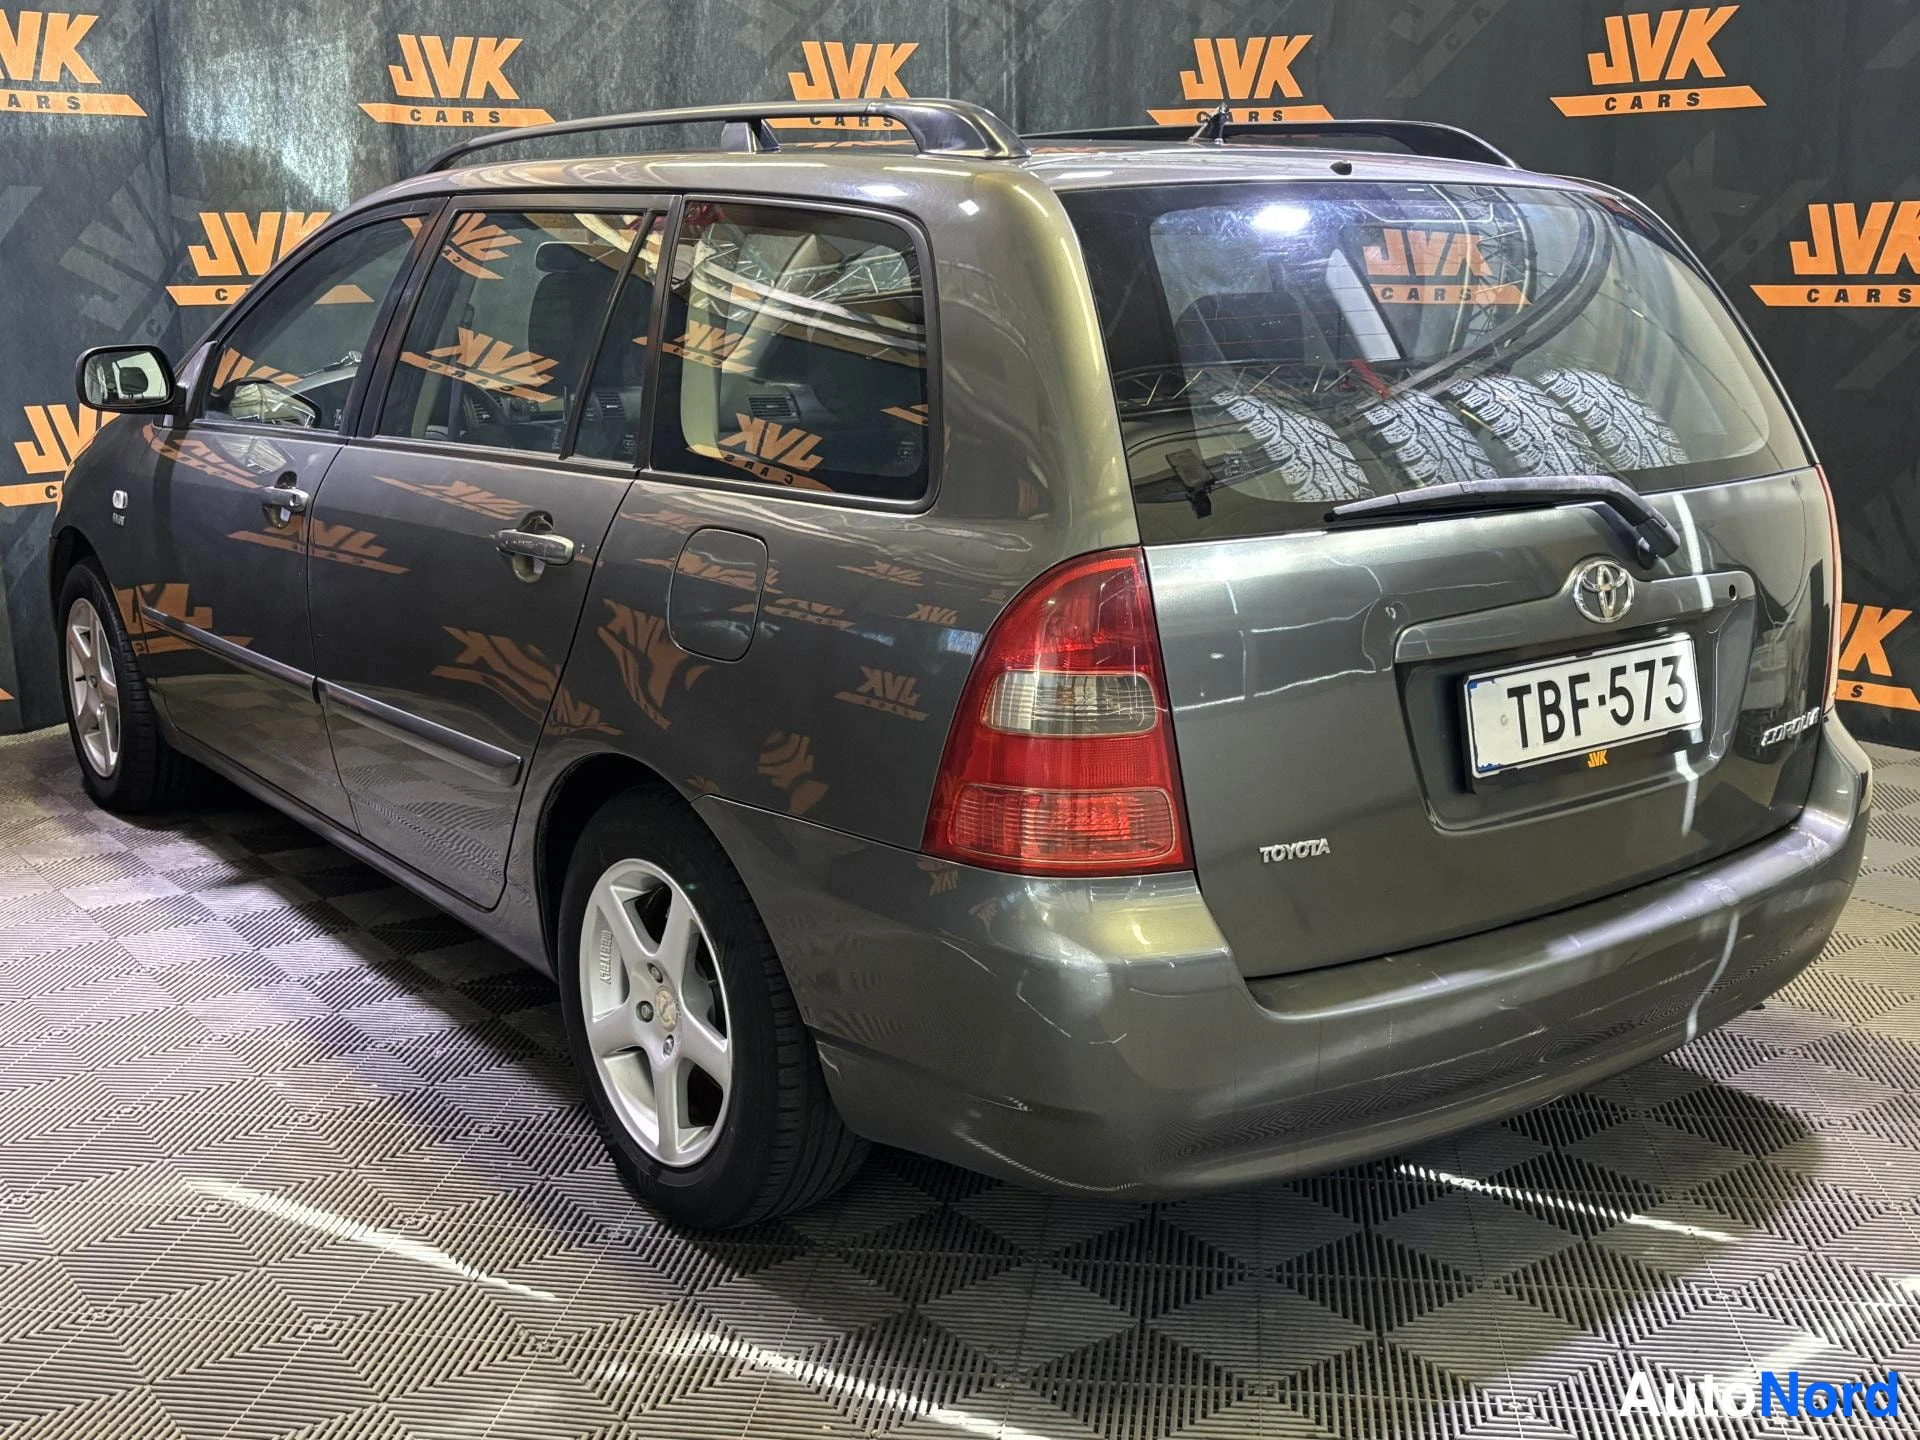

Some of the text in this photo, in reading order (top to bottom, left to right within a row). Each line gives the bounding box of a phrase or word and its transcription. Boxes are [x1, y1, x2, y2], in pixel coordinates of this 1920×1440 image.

[0, 8, 101, 84] VK
[1587, 5, 1740, 86] JVK
[388, 34, 524, 100] JVK
[787, 41, 920, 100] JVK
[1180, 34, 1314, 100] JVK
[7, 94, 81, 111] ARS
[409, 108, 501, 124] CARS
[1196, 110, 1283, 124] CRS
[1604, 92, 1701, 111] CARS
[1362, 228, 1493, 277] JVK
[1381, 287, 1472, 302] CARS
[1806, 288, 1912, 303] CARS
[14, 402, 121, 474] JV
[1506, 655, 1688, 749] TBF-573
[1587, 749, 1609, 768] JVK
[1259, 837, 1331, 863] TOYOTA
